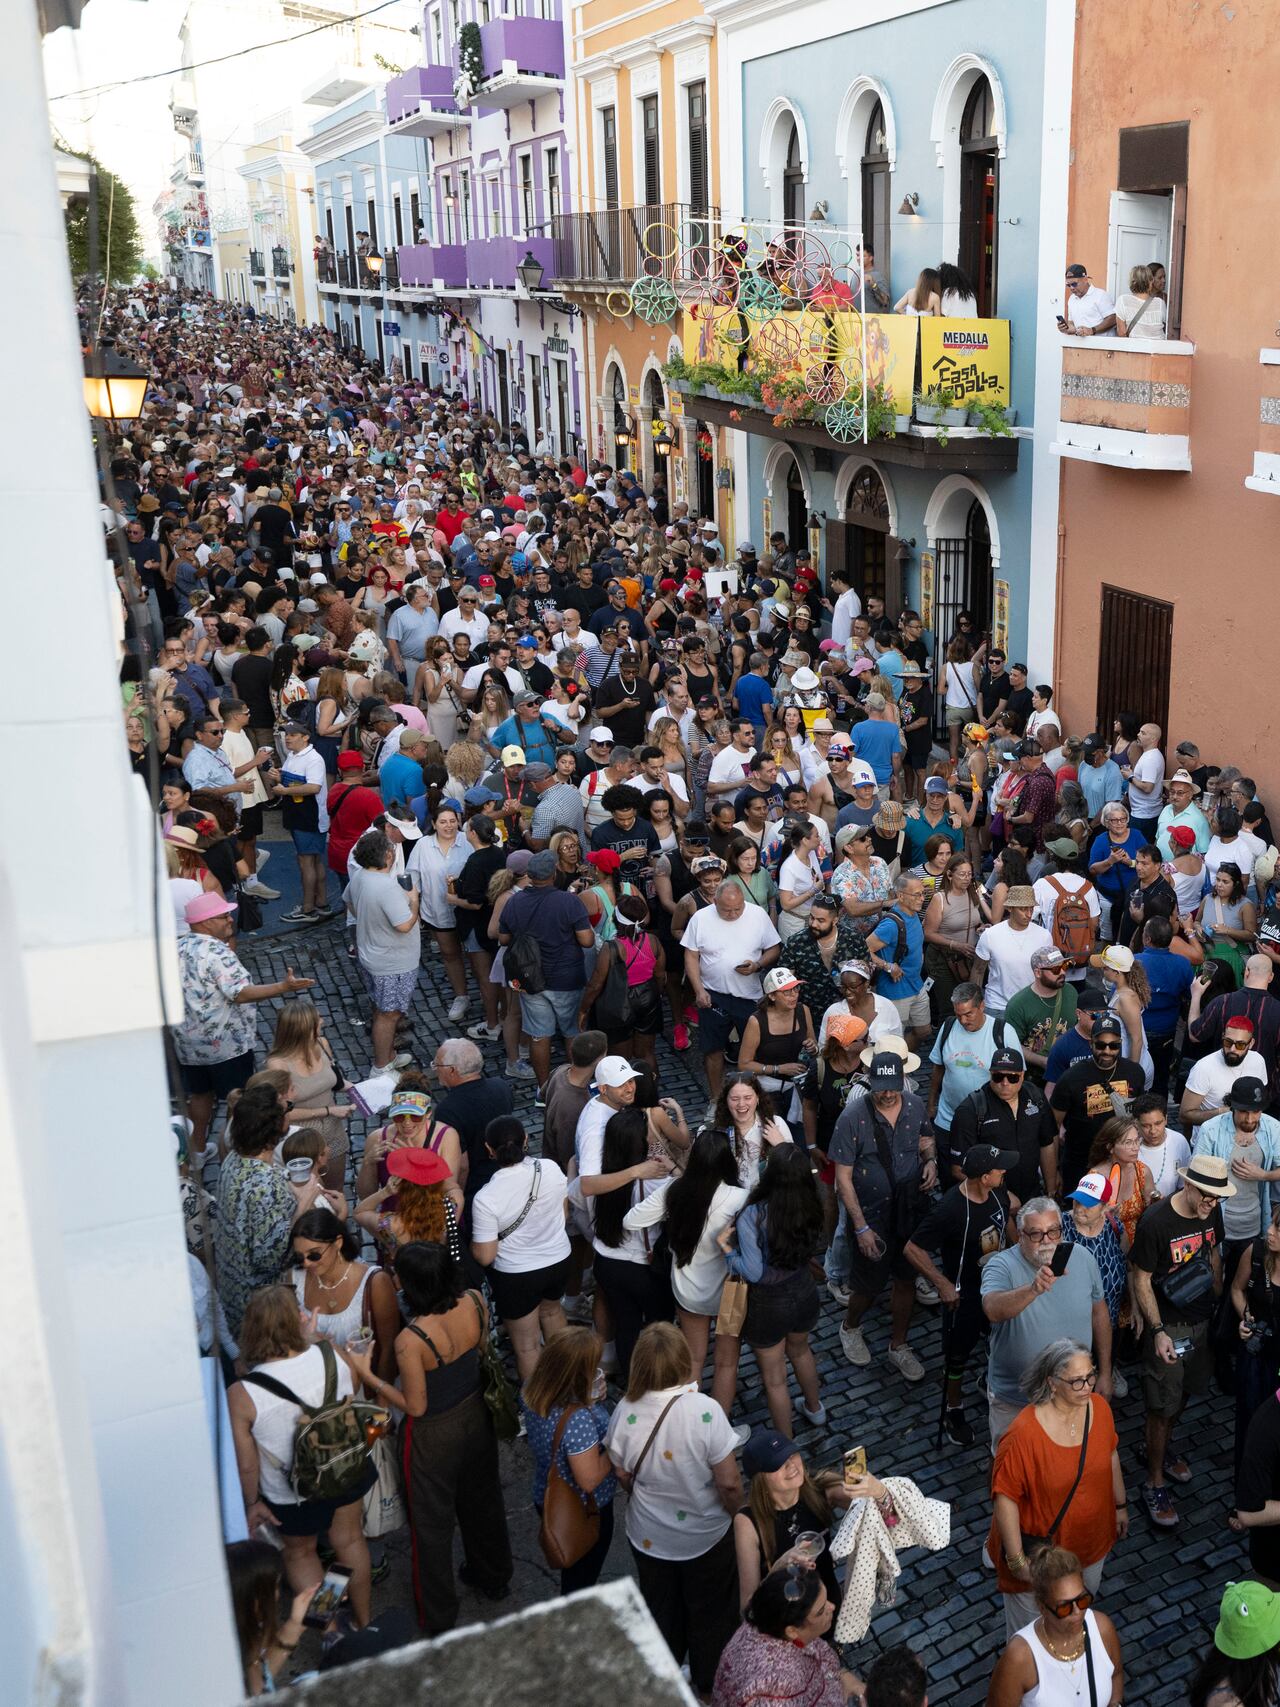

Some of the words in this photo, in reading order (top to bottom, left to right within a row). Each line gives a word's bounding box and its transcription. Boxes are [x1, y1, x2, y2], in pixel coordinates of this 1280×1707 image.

[943, 332, 988, 344] MEDALLA
[420, 344, 438, 354] ATM
[876, 1064, 897, 1076] intel
